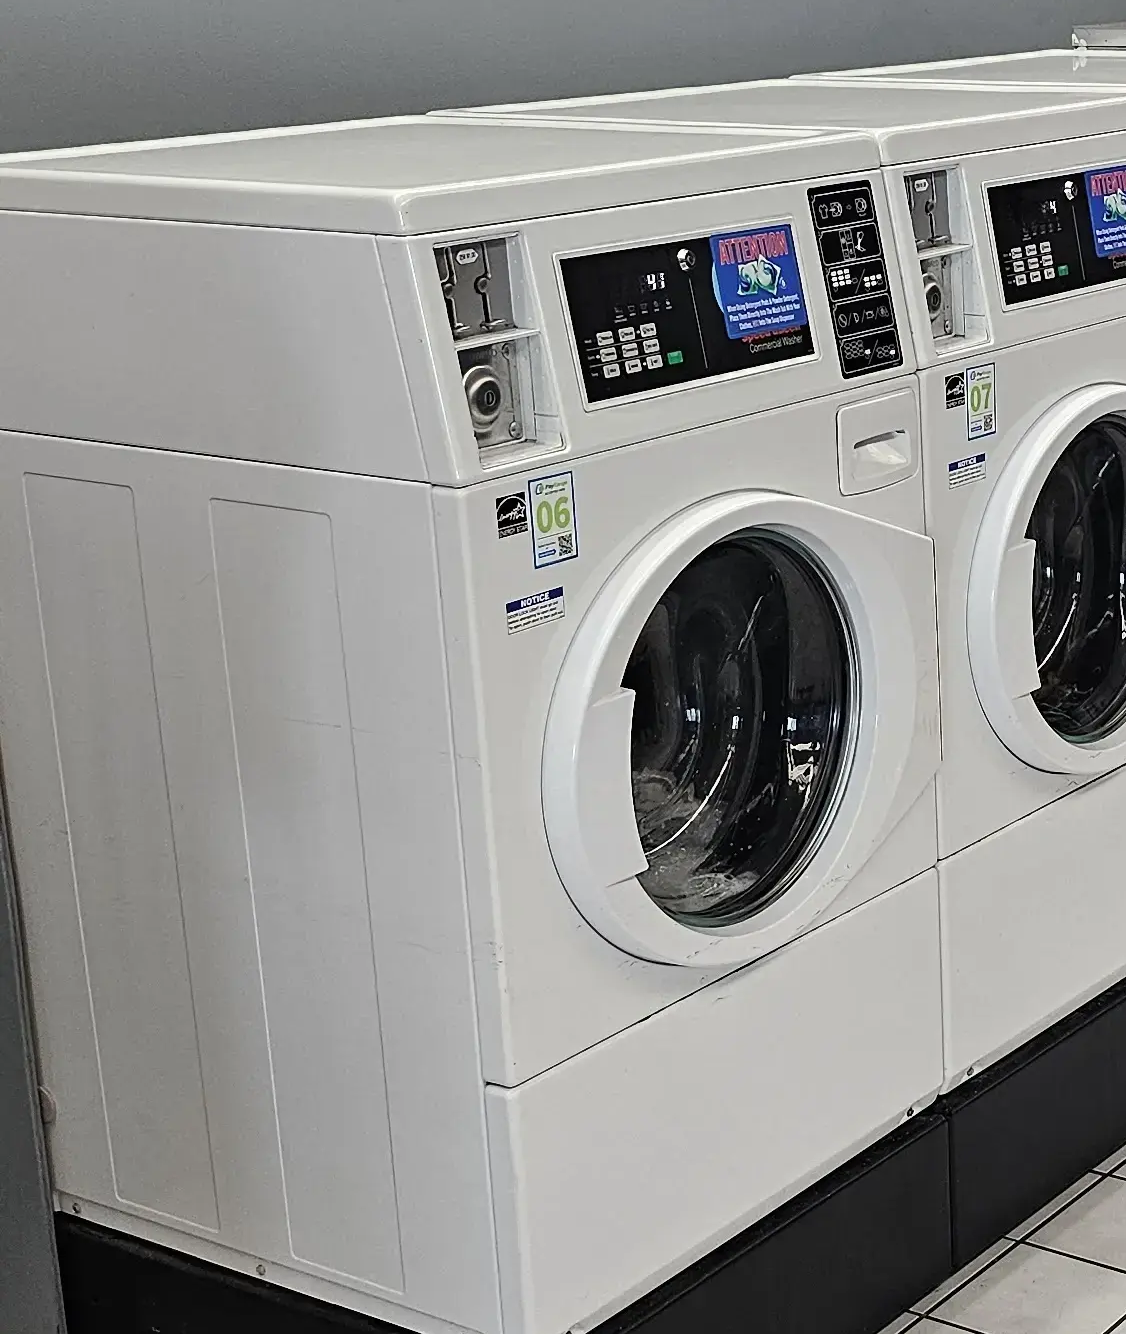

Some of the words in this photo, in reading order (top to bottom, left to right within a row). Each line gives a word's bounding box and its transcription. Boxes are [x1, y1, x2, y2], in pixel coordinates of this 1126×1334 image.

[719, 230, 788, 265] ATTENTION
[749, 338, 782, 353] Commercial
[782, 334, 803, 347] Washer
[970, 382, 992, 412] 07
[536, 496, 571, 533] 06
[520, 592, 550, 608] NOTICE
